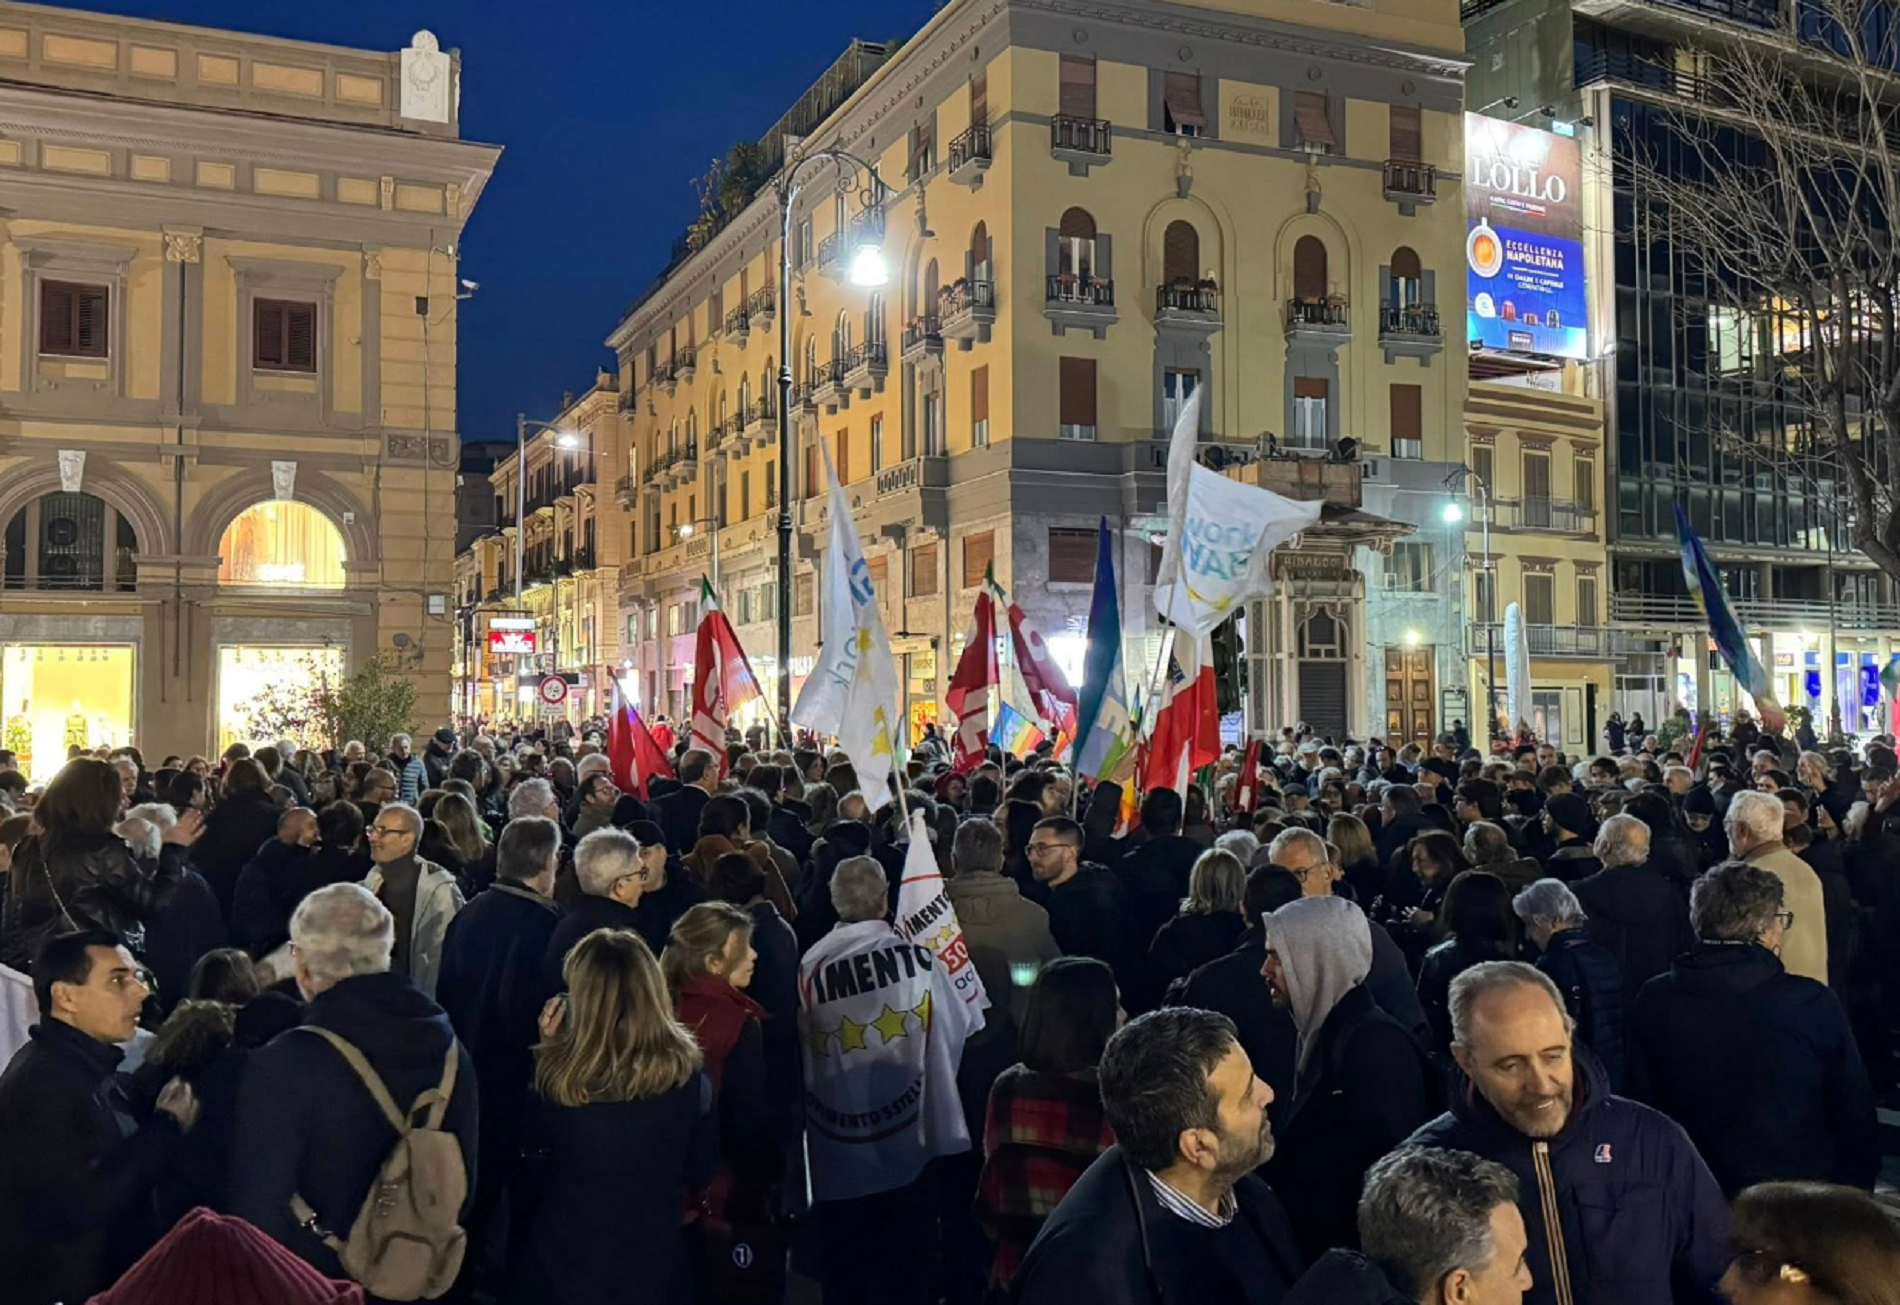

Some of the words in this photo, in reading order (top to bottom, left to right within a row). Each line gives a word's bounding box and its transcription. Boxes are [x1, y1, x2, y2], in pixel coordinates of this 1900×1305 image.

[1472, 157, 1566, 203] LOLLO
[1506, 239, 1563, 259] ECCELLENZA
[1506, 249, 1564, 271] NAPOLETANA
